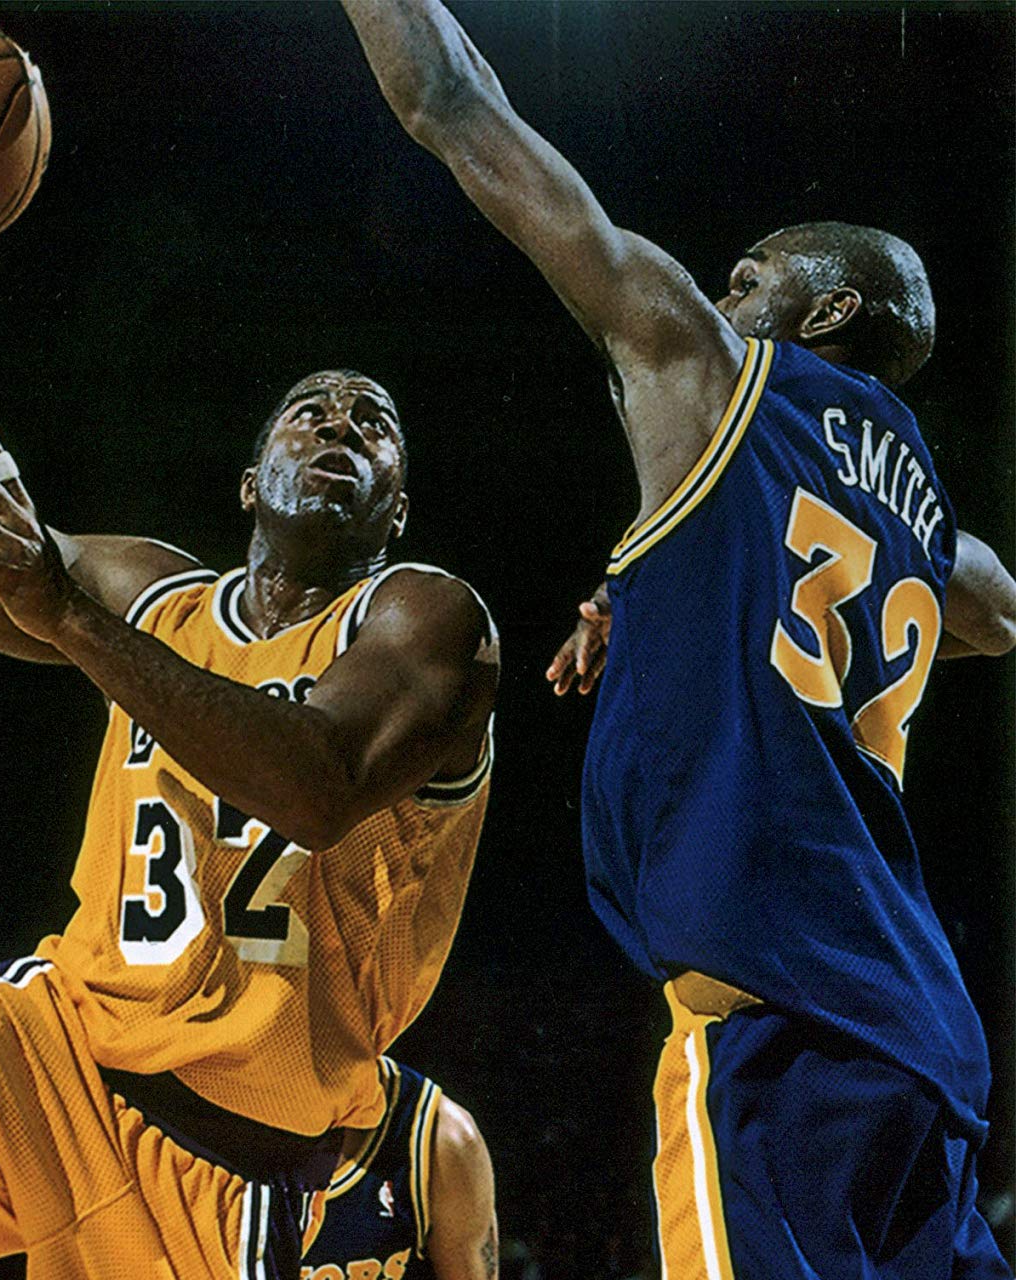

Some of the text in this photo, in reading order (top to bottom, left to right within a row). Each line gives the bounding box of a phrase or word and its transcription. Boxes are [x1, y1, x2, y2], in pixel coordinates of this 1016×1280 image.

[823, 408, 944, 560] SMITH
[770, 485, 943, 792] 32
[120, 796, 311, 967] 32
